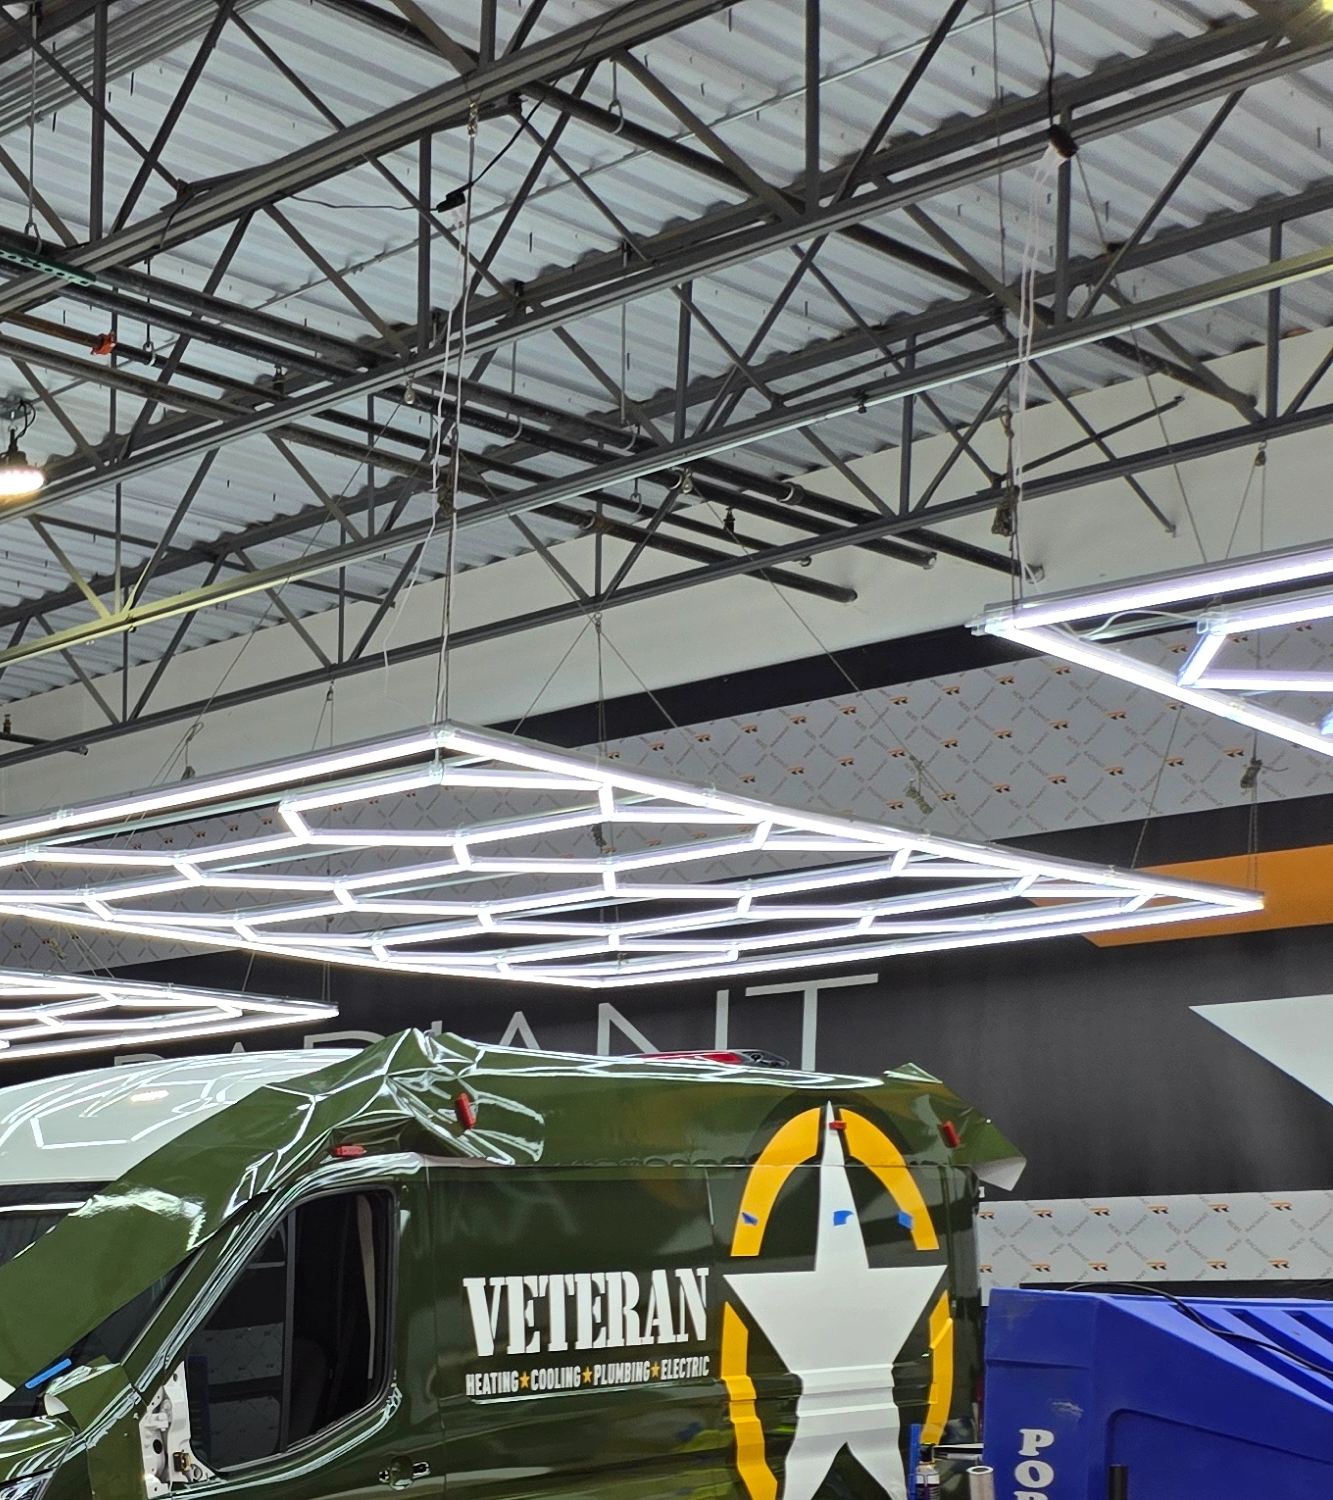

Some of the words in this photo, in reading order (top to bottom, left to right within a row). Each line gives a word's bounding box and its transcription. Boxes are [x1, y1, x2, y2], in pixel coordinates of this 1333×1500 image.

[463, 1267, 709, 1356] VETERAN
[466, 1370, 519, 1396] HEATING
[530, 1365, 581, 1390] COOLING
[593, 1360, 650, 1386] PLUMBING
[660, 1355, 709, 1380] ELECTRIC
